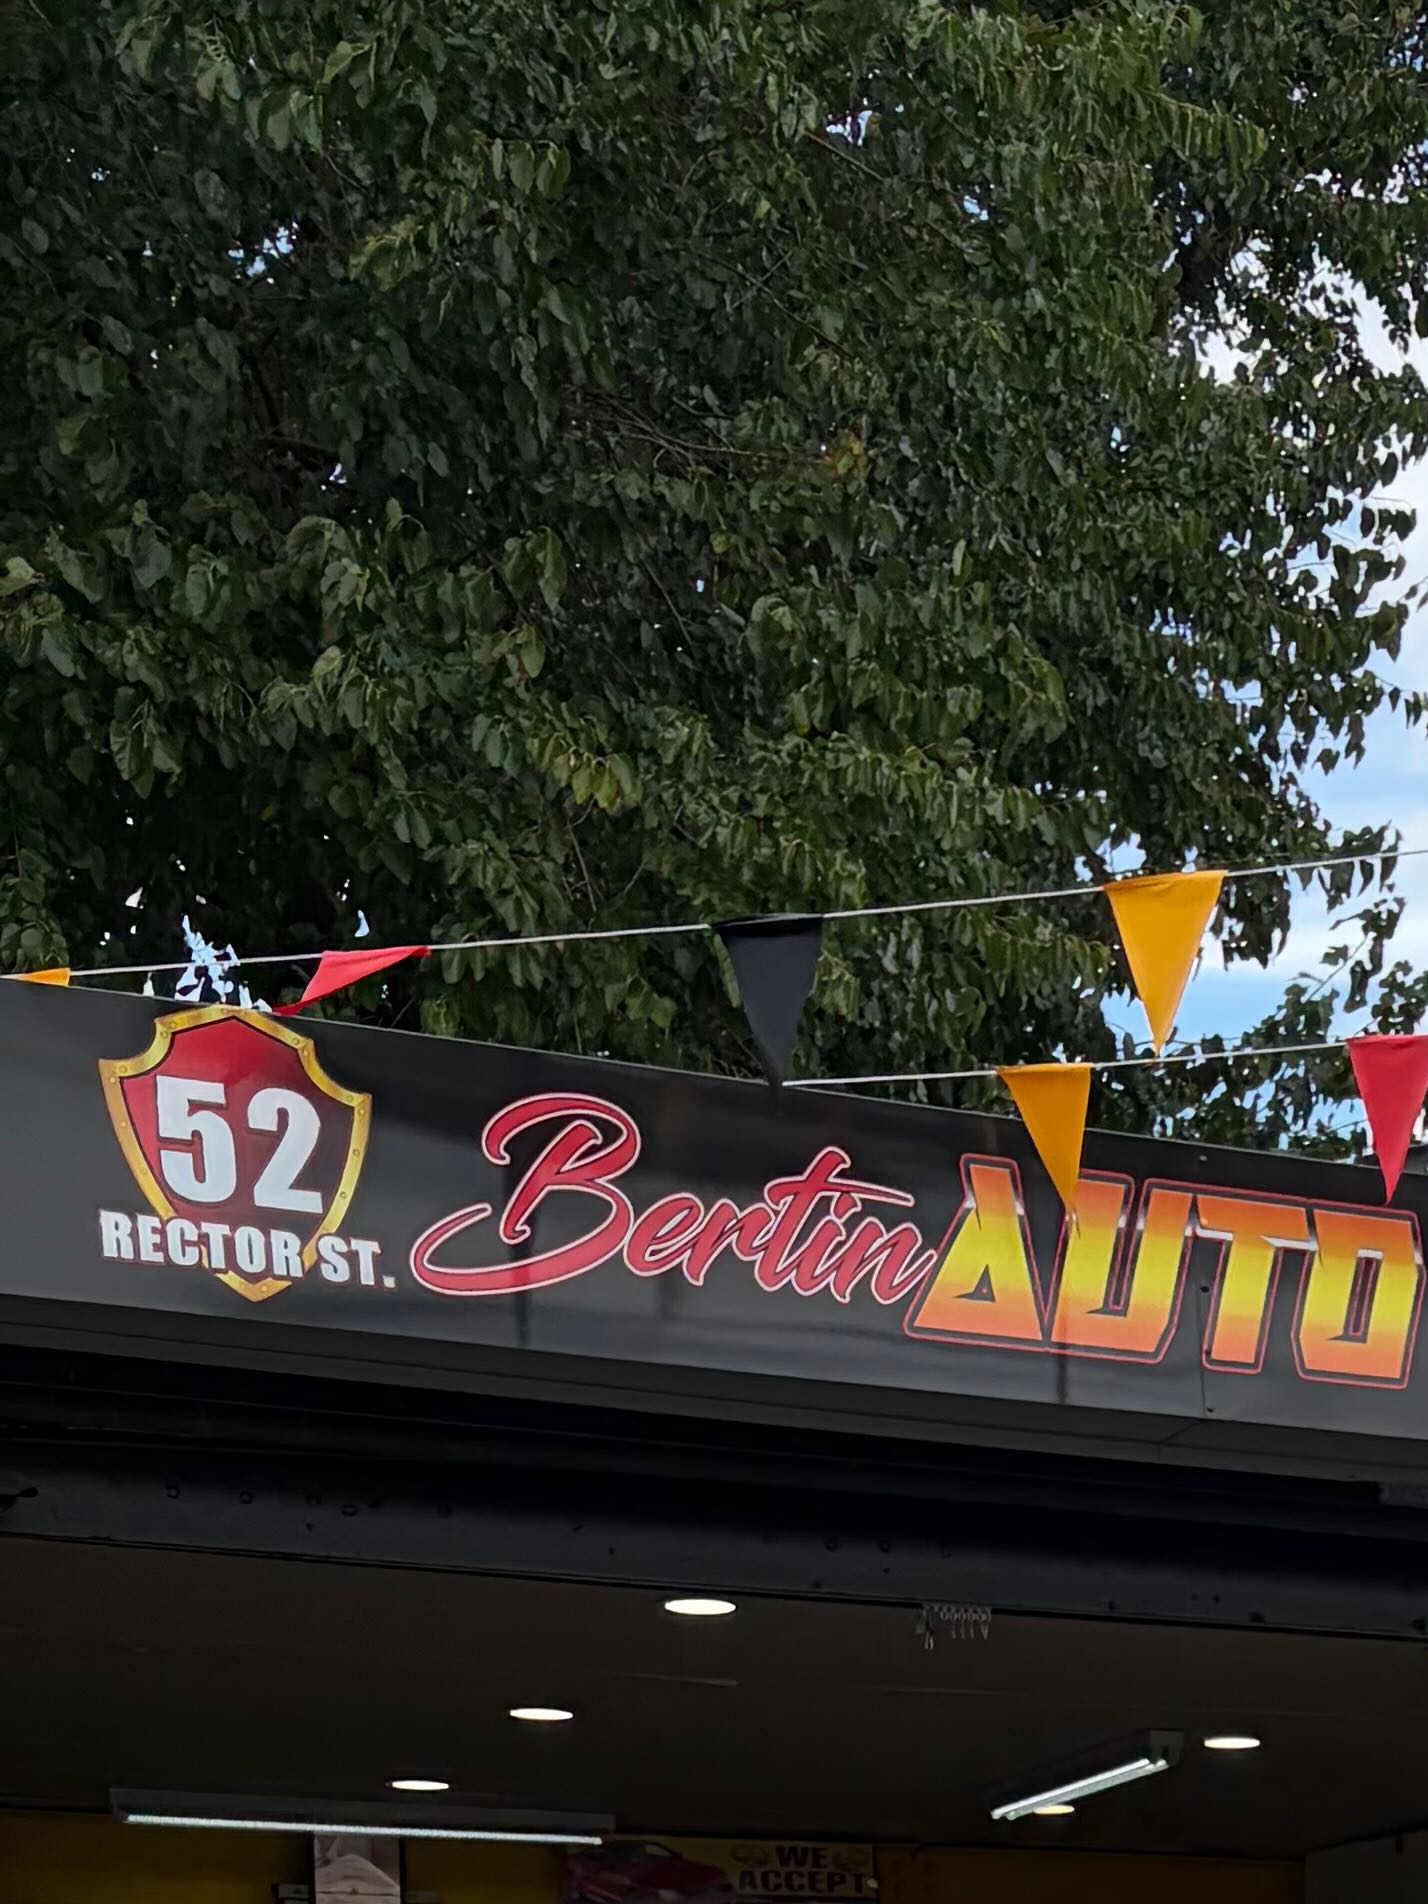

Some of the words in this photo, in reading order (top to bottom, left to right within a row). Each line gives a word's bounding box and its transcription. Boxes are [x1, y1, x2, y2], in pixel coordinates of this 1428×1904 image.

[156, 1075, 323, 1213] 52
[98, 1209, 303, 1280] RECTOR
[319, 1234, 396, 1290] ST.
[410, 1092, 938, 1306] Bertin
[904, 1154, 1426, 1389] AUTO
[739, 1870, 866, 1894] ACCEPT
[775, 1846, 830, 1868] WE
